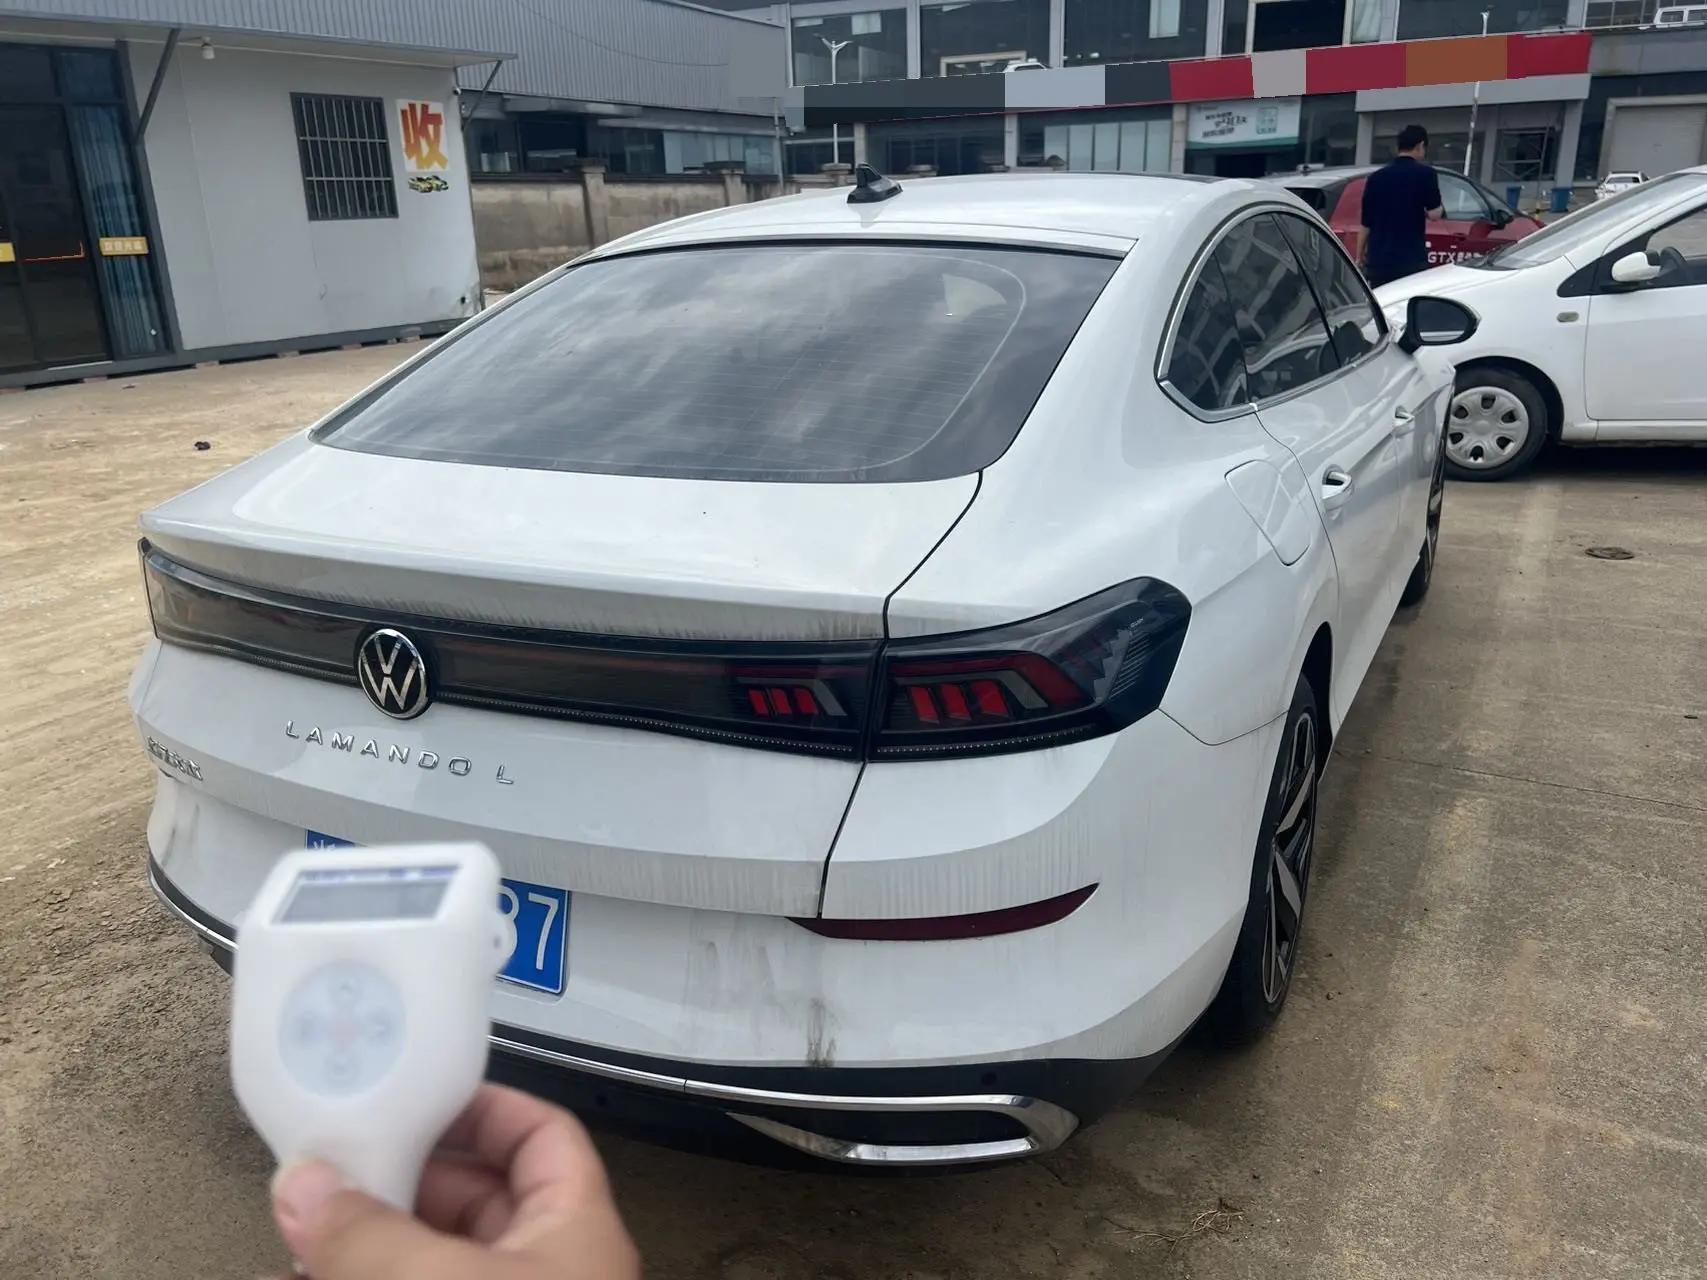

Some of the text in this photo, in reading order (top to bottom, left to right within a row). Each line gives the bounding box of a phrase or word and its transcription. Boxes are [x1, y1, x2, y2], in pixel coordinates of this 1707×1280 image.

[401, 103, 449, 170] 收
[285, 720, 514, 784] LAMANDO L
